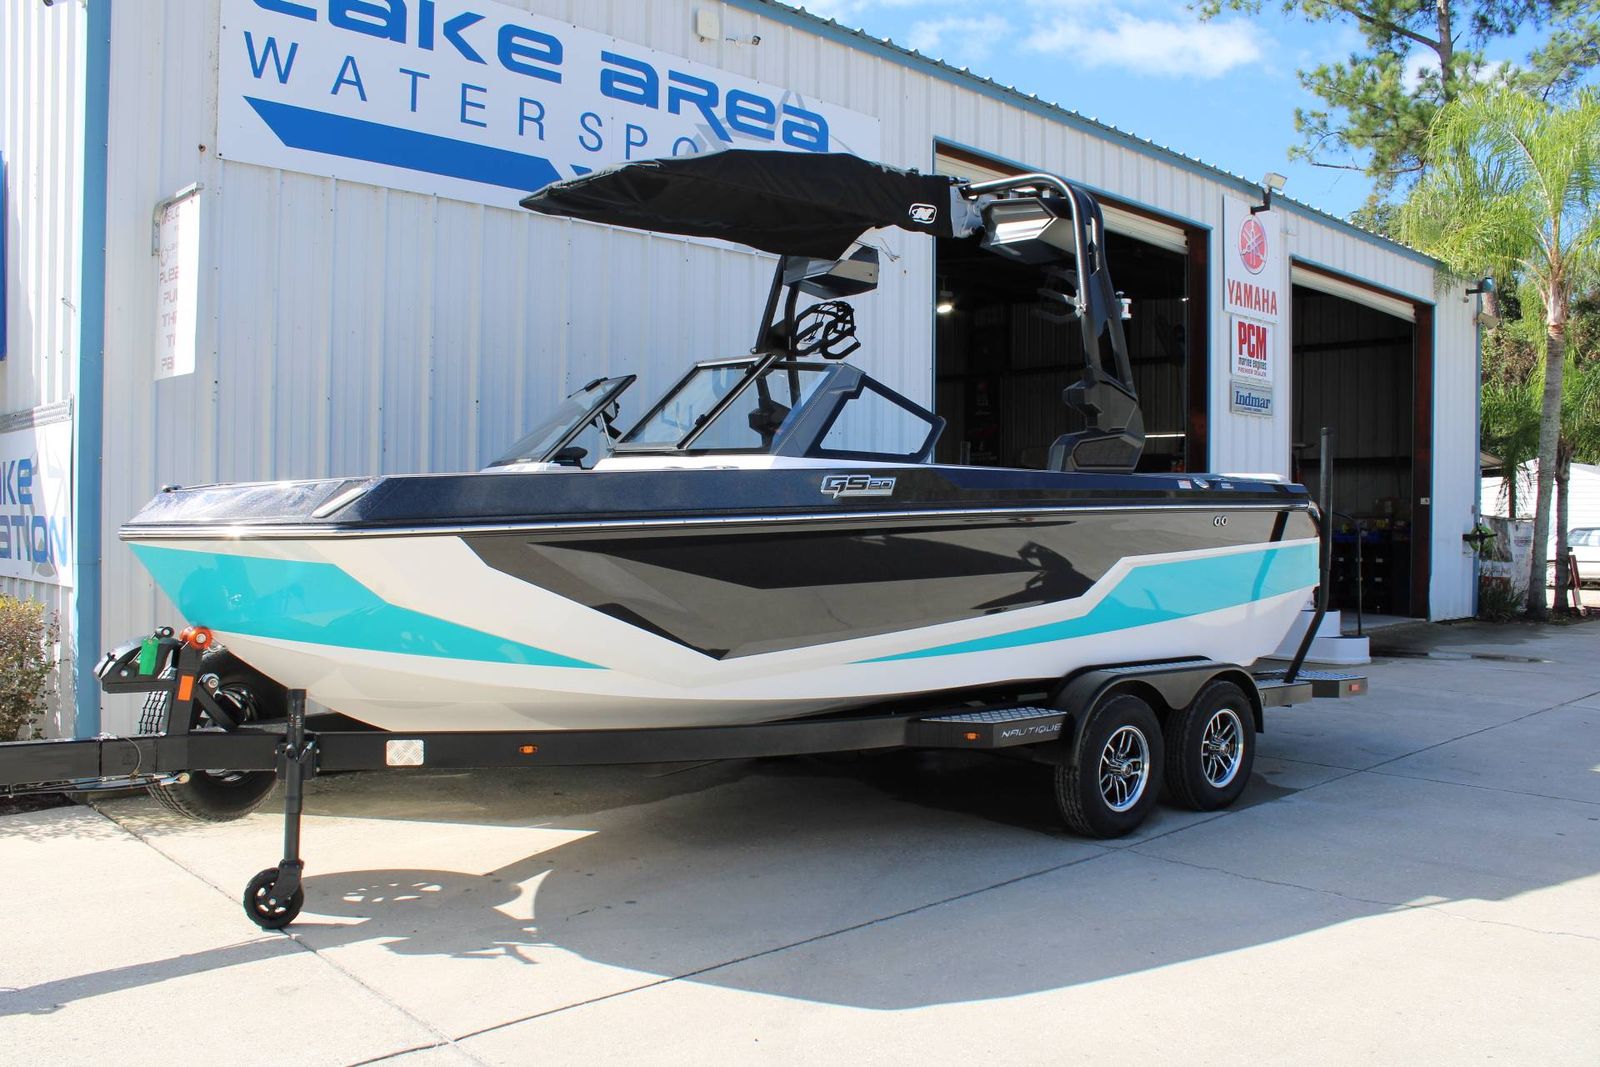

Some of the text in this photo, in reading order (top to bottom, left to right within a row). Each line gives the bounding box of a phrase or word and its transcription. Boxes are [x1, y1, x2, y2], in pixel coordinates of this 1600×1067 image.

[254, 0, 563, 84] ake
[1227, 278, 1277, 315] YAMAHA
[1238, 321, 1266, 360] PCM
[1235, 391, 1271, 409] Indmar
[1001, 723, 1062, 738] NAUTIQUE
